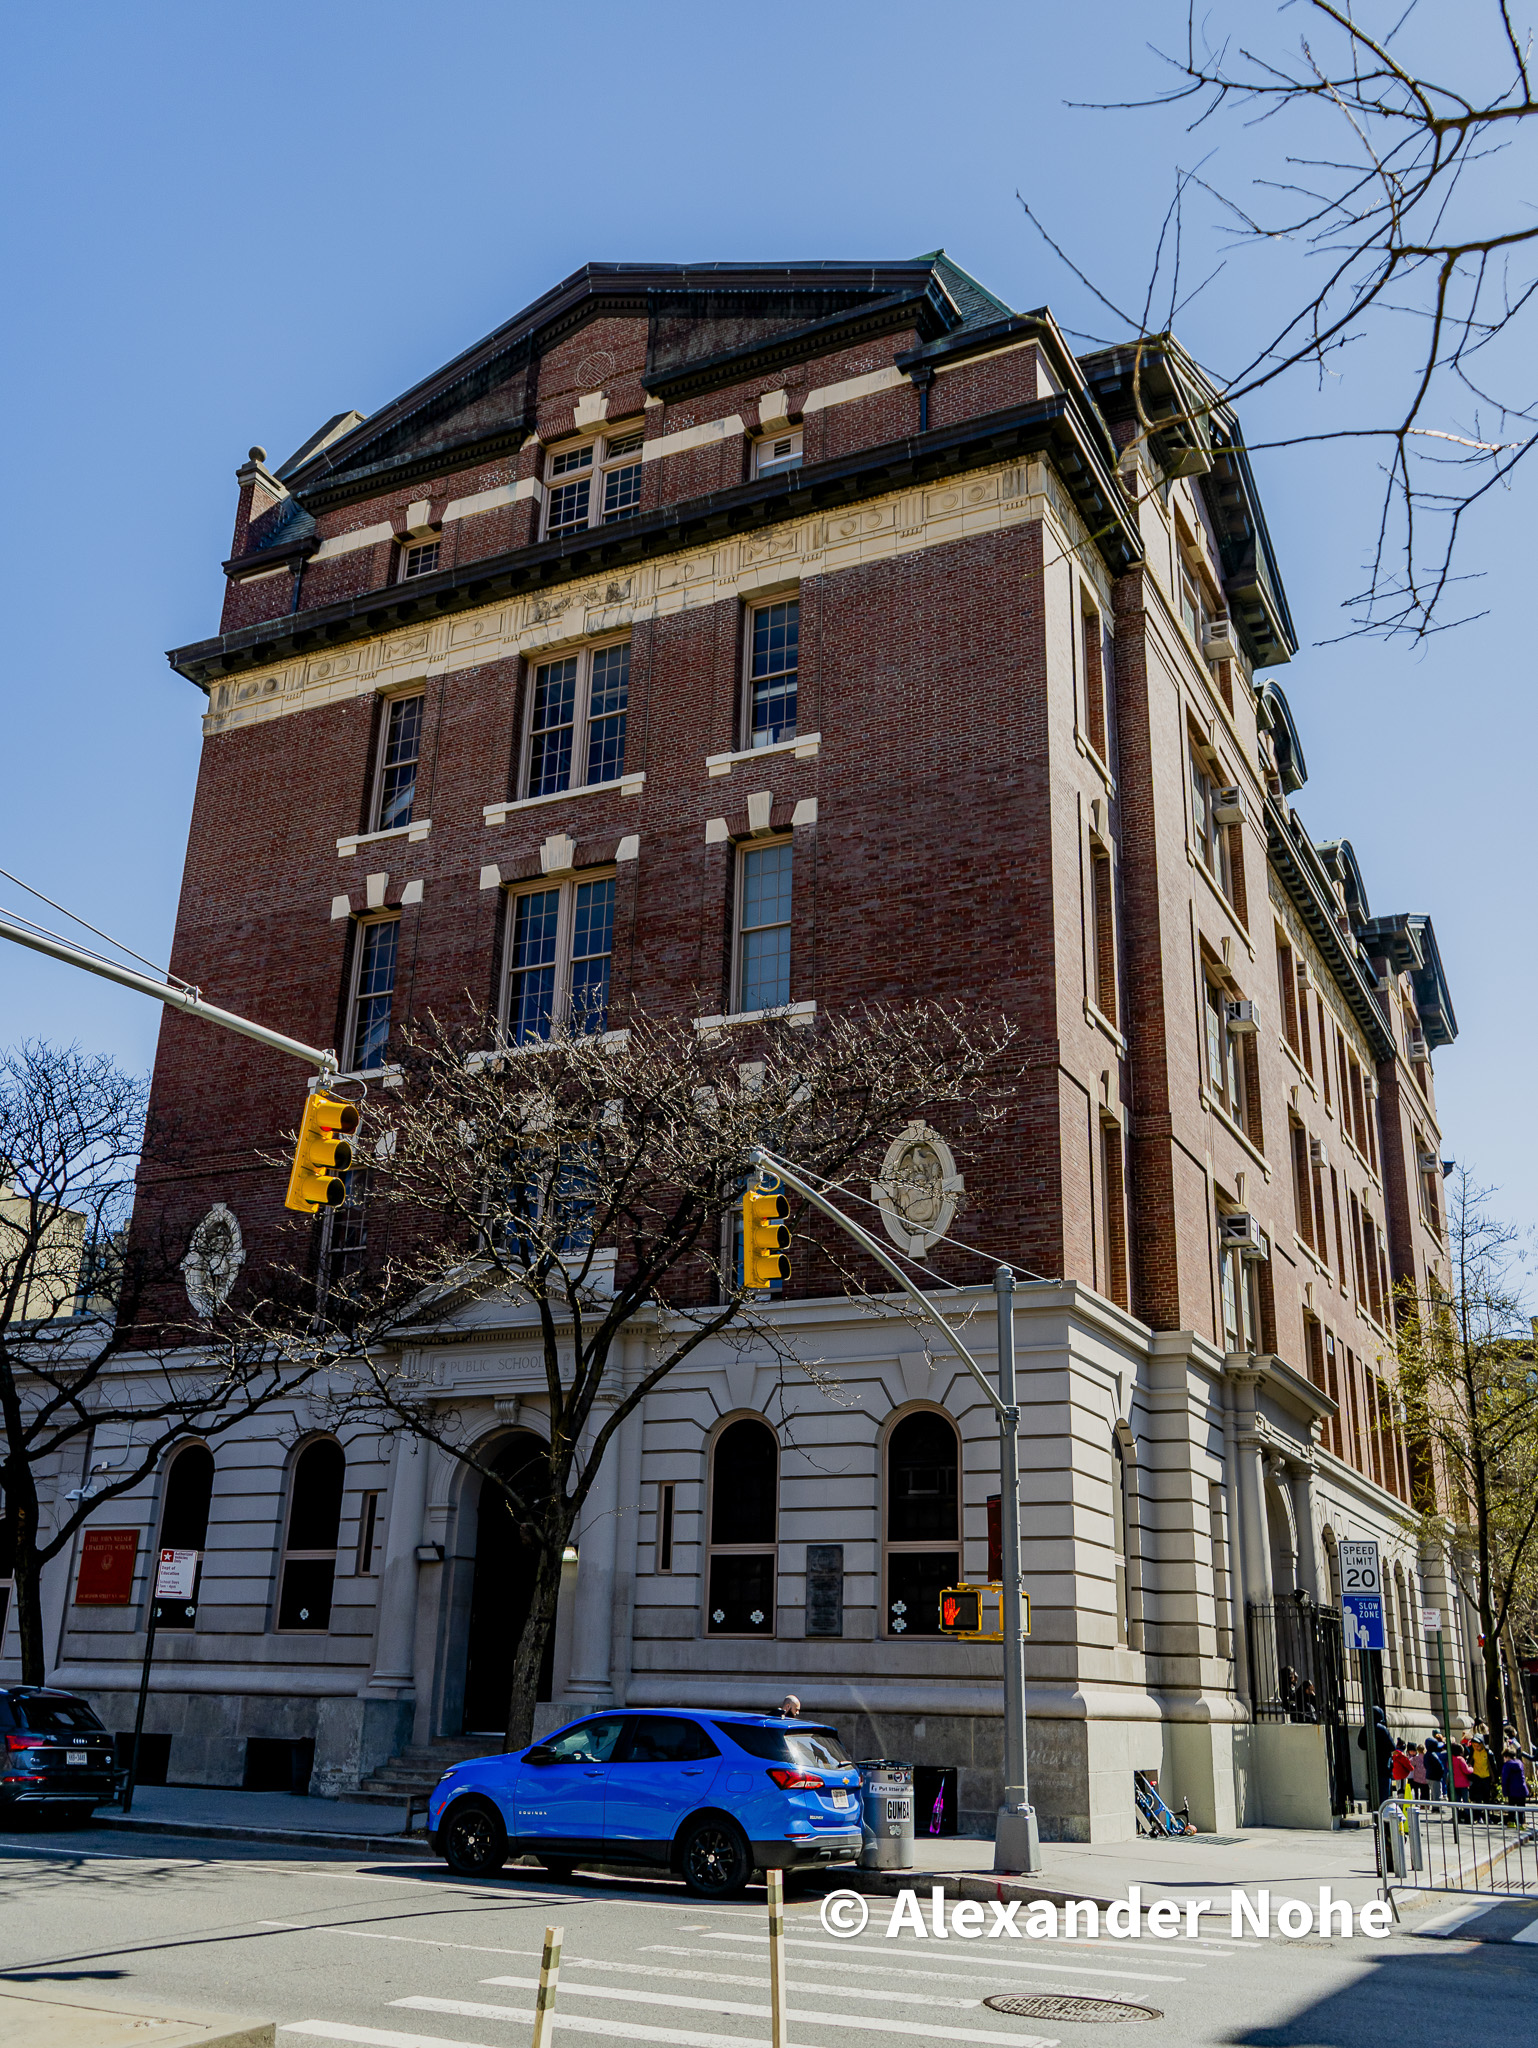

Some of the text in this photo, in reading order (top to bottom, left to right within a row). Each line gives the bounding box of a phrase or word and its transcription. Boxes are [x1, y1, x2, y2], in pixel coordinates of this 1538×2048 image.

[450, 1356, 544, 1373] PUBLIC SCHOOL
[1343, 1546, 1374, 1555] SPEED
[1346, 1557, 1373, 1566] LIMIT
[1346, 1569, 1375, 1587] 20
[1359, 1602, 1379, 1610] SLOW
[1359, 1610, 1380, 1619] ZONE
[887, 1800, 909, 1820] GUMBA
